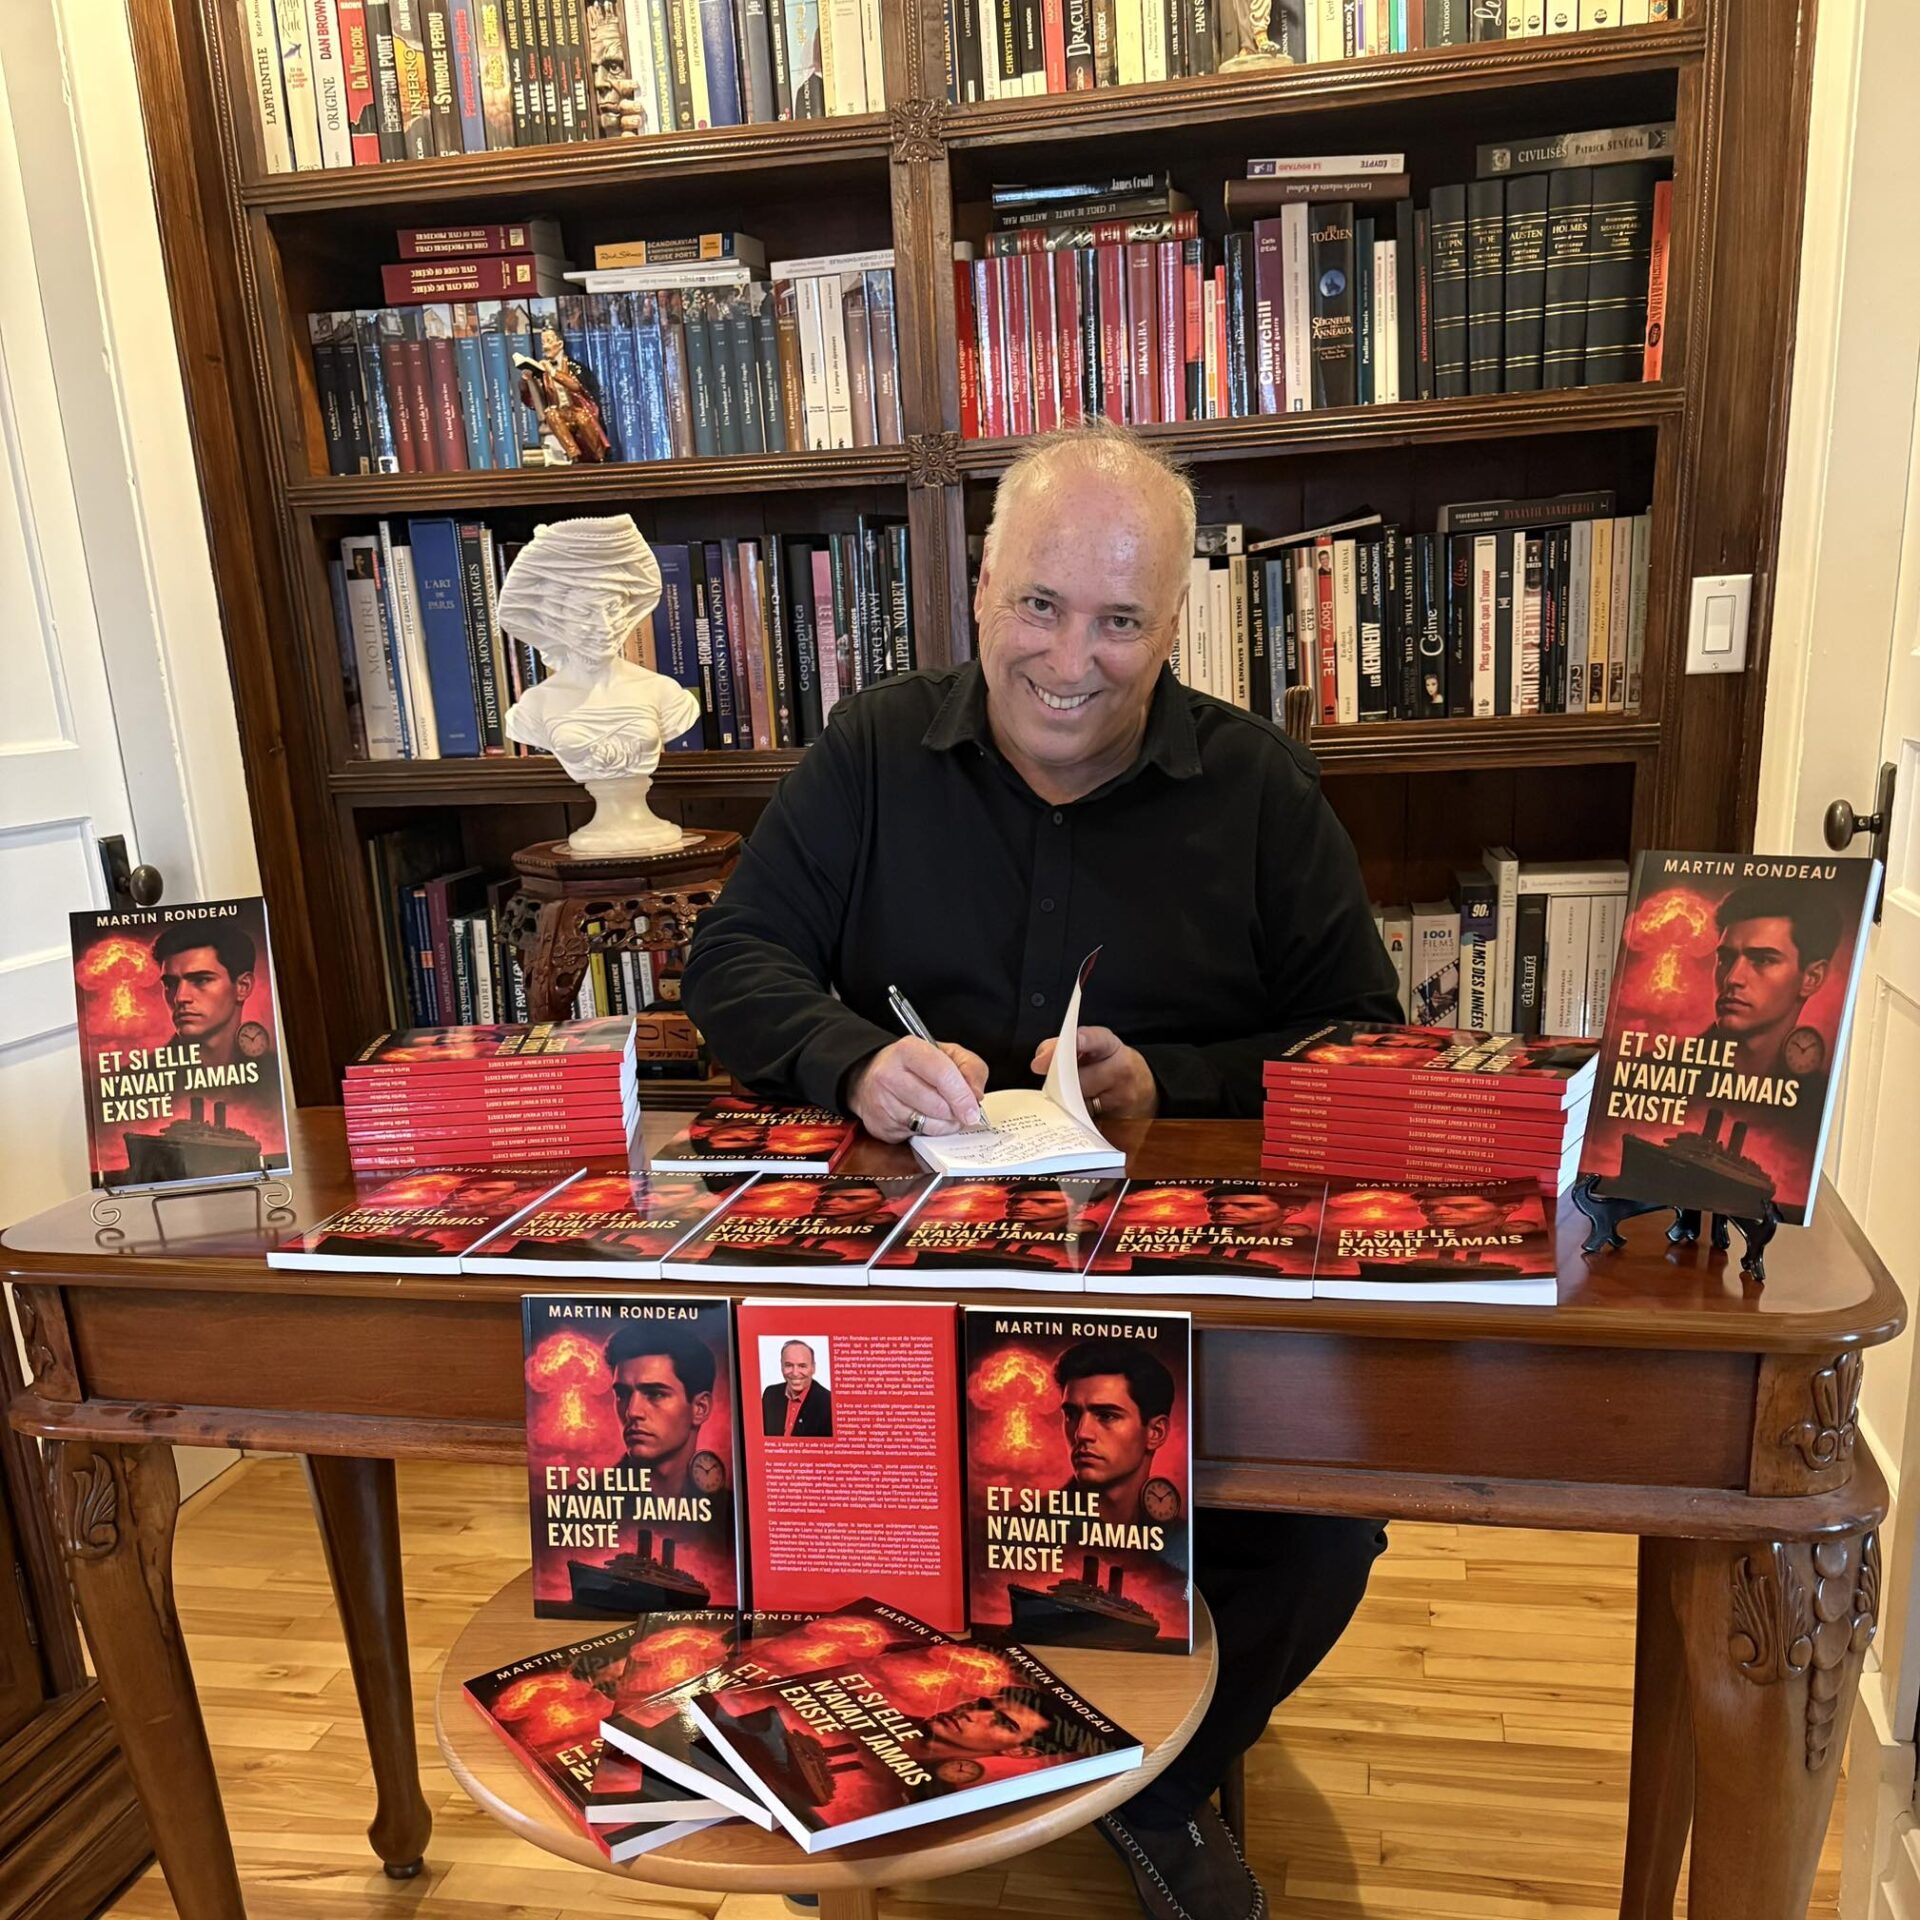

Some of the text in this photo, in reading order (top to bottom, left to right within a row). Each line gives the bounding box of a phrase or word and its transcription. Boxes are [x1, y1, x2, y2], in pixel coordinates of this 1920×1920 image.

[319, 38, 332, 59] DAN
[1004, 21, 1014, 74] CHRYSTINE
[1098, 11, 1108, 53] LE CODEX
[350, 25, 369, 91] DA VINCI CODE
[377, 34, 393, 71] POINT
[427, 12, 453, 115] LE SYMBOLE PERDU
[257, 47, 278, 126] LABYRINTHE
[405, 47, 425, 117] INFERNO
[327, 76, 340, 131] ORIGINE
[647, 237, 698, 249] SCANDINAVIAN
[1311, 229, 1353, 243] TOLKIEN
[1438, 239, 1463, 249] LUPIN
[1479, 235, 1496, 244] POE
[1510, 229, 1543, 241] AUSTEN
[1552, 223, 1588, 234] HOLMES
[649, 250, 697, 262] CRUISE PORTS
[1259, 300, 1273, 386] Churchill
[1271, 317, 1281, 384] seigneur de guerre
[1313, 327, 1354, 339] ANNEAUX
[469, 563, 485, 607] IMAGES
[428, 601, 455, 610] PARIS
[891, 580, 909, 629] NOIRET
[1478, 569, 1491, 672] Plus grands que l'amour
[475, 621, 491, 663] MONDE
[710, 576, 731, 716] RELIGIONS DU MONDE
[793, 604, 810, 692] Geographica
[868, 592, 884, 675] JAMES DEAN
[1236, 632, 1243, 643] DU
[1253, 619, 1264, 657] Elizabeth
[1322, 601, 1335, 675] Body LIFE
[1361, 622, 1381, 687] LES KENNEDY
[1521, 597, 1541, 708] KILLER INSTINCT
[483, 678, 499, 729] HISTOIRE
[1664, 859, 1838, 881] MARTIN RONDEAU
[96, 905, 238, 928] MARTIN RONDEAU
[1423, 930, 1452, 939] 1001
[1423, 939, 1454, 947] FILMS
[1472, 968, 1486, 988] DES
[1521, 955, 1537, 1008] CÉLÉBRITÉ
[1471, 988, 1487, 1029] ANNÉES
[99, 1044, 202, 1074] ET SI ELLE
[1619, 1030, 1738, 1069] ET SI ELLE
[99, 1062, 260, 1098] N'AVAIT JAMAIS
[1612, 1061, 1800, 1108] N'AVAIT JAMAIS
[102, 1092, 174, 1123] EXISTÉ
[1606, 1091, 1688, 1126] EXISTÉ
[1355, 1180, 1509, 1189] MARTIN RONDEAU
[714, 1225, 874, 1235] N'AVAIT JAMAIS
[753, 1217, 775, 1225] SI
[778, 1217, 827, 1226] ELLE
[1340, 1229, 1456, 1239] ET SI ELLE
[1338, 1235, 1524, 1248] N'AVAIT JAMAIS
[548, 1305, 699, 1320] MARTIN RONDEAU
[995, 1320, 1158, 1340] MARTIN RONDEAU
[546, 1466, 652, 1493] ET SI ELLE
[547, 1495, 712, 1523] N'AVAIT JAMAIS
[987, 1486, 1100, 1518] ET SI ELLE
[548, 1522, 620, 1548] EXISTÉ
[987, 1516, 1165, 1551] N'AVAIT JAMAIS
[987, 1545, 1064, 1574] EXISTÉ
[666, 1613, 820, 1623] MARTIN RONDEA
[872, 1605, 926, 1637] MARTIN
[495, 1628, 636, 1681] MARTIN RONDEA
[838, 1673, 924, 1742] ET SI ELLE
[1005, 1646, 1115, 1734] MARTIN RONDEAU
[779, 1685, 847, 1736] EXISTÉ
[809, 1679, 933, 1788] N'AVAIT JAMAIS
